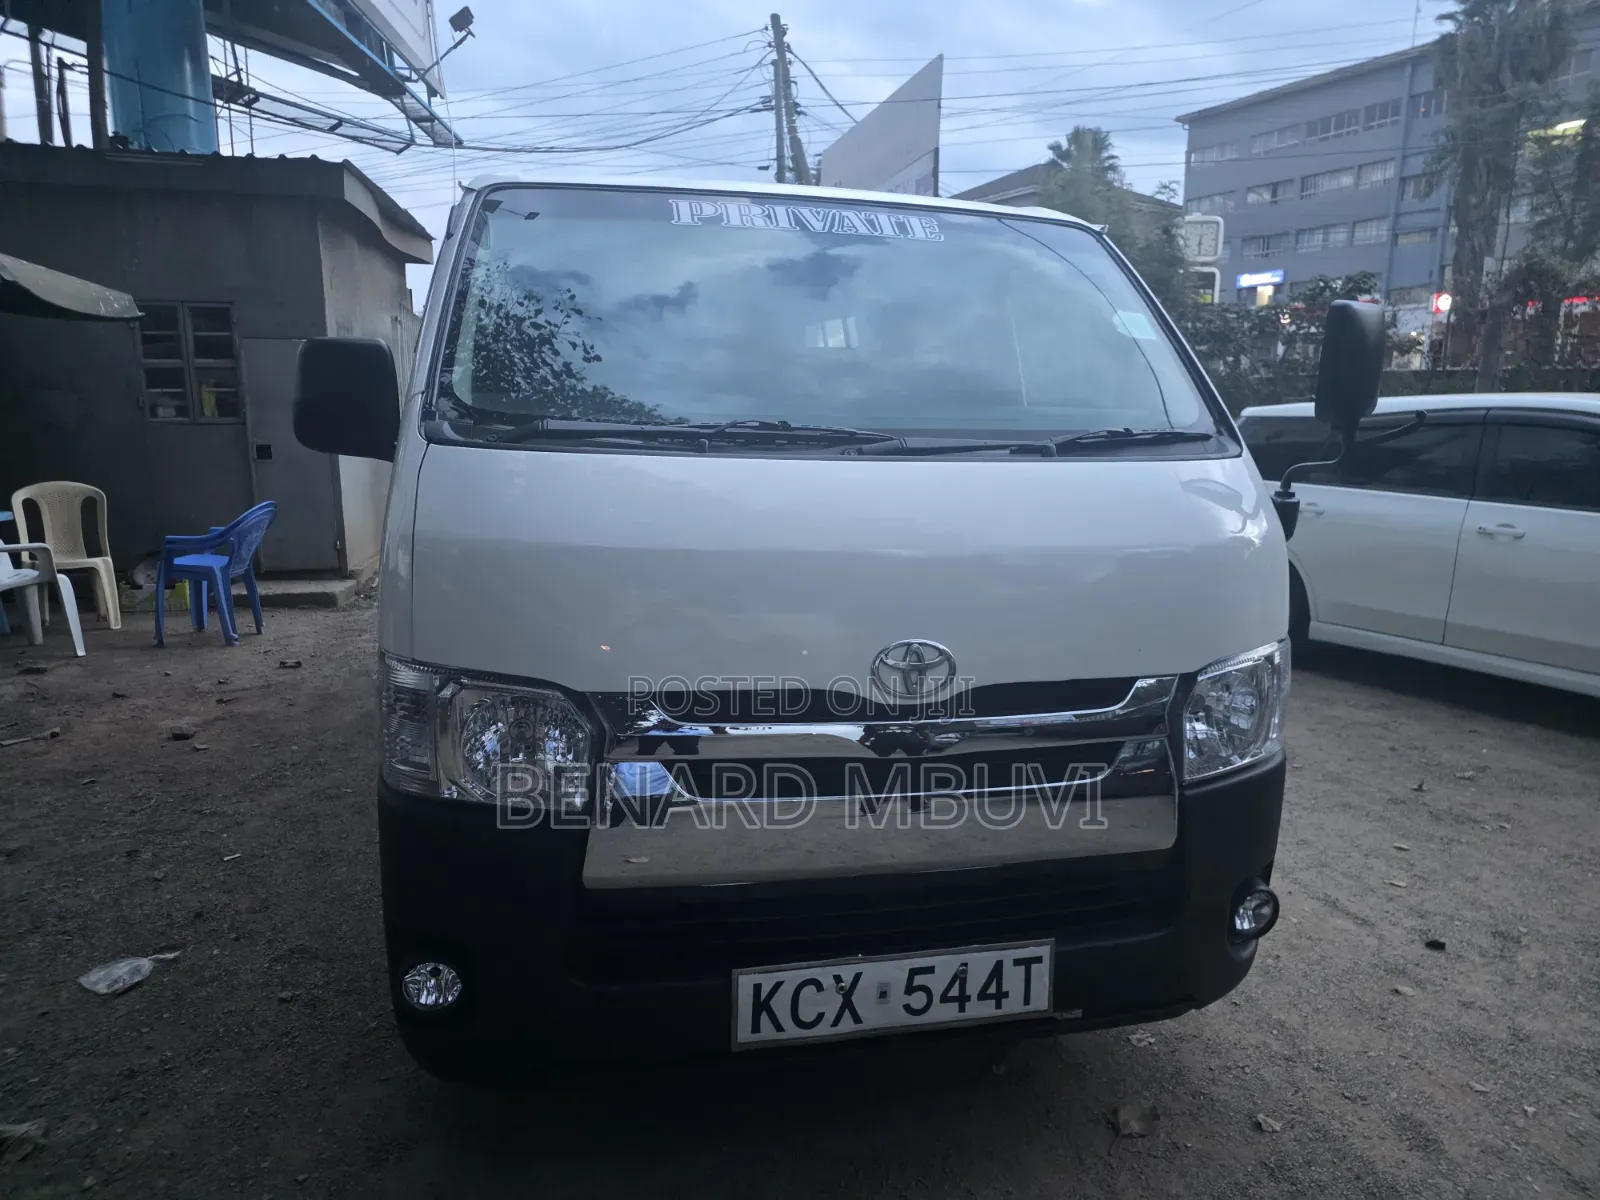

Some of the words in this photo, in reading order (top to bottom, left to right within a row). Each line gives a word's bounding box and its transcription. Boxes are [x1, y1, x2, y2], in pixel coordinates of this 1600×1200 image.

[668, 199, 944, 241] PRIVATE
[750, 971, 864, 1034] KCX
[902, 955, 1044, 1017] 544T
